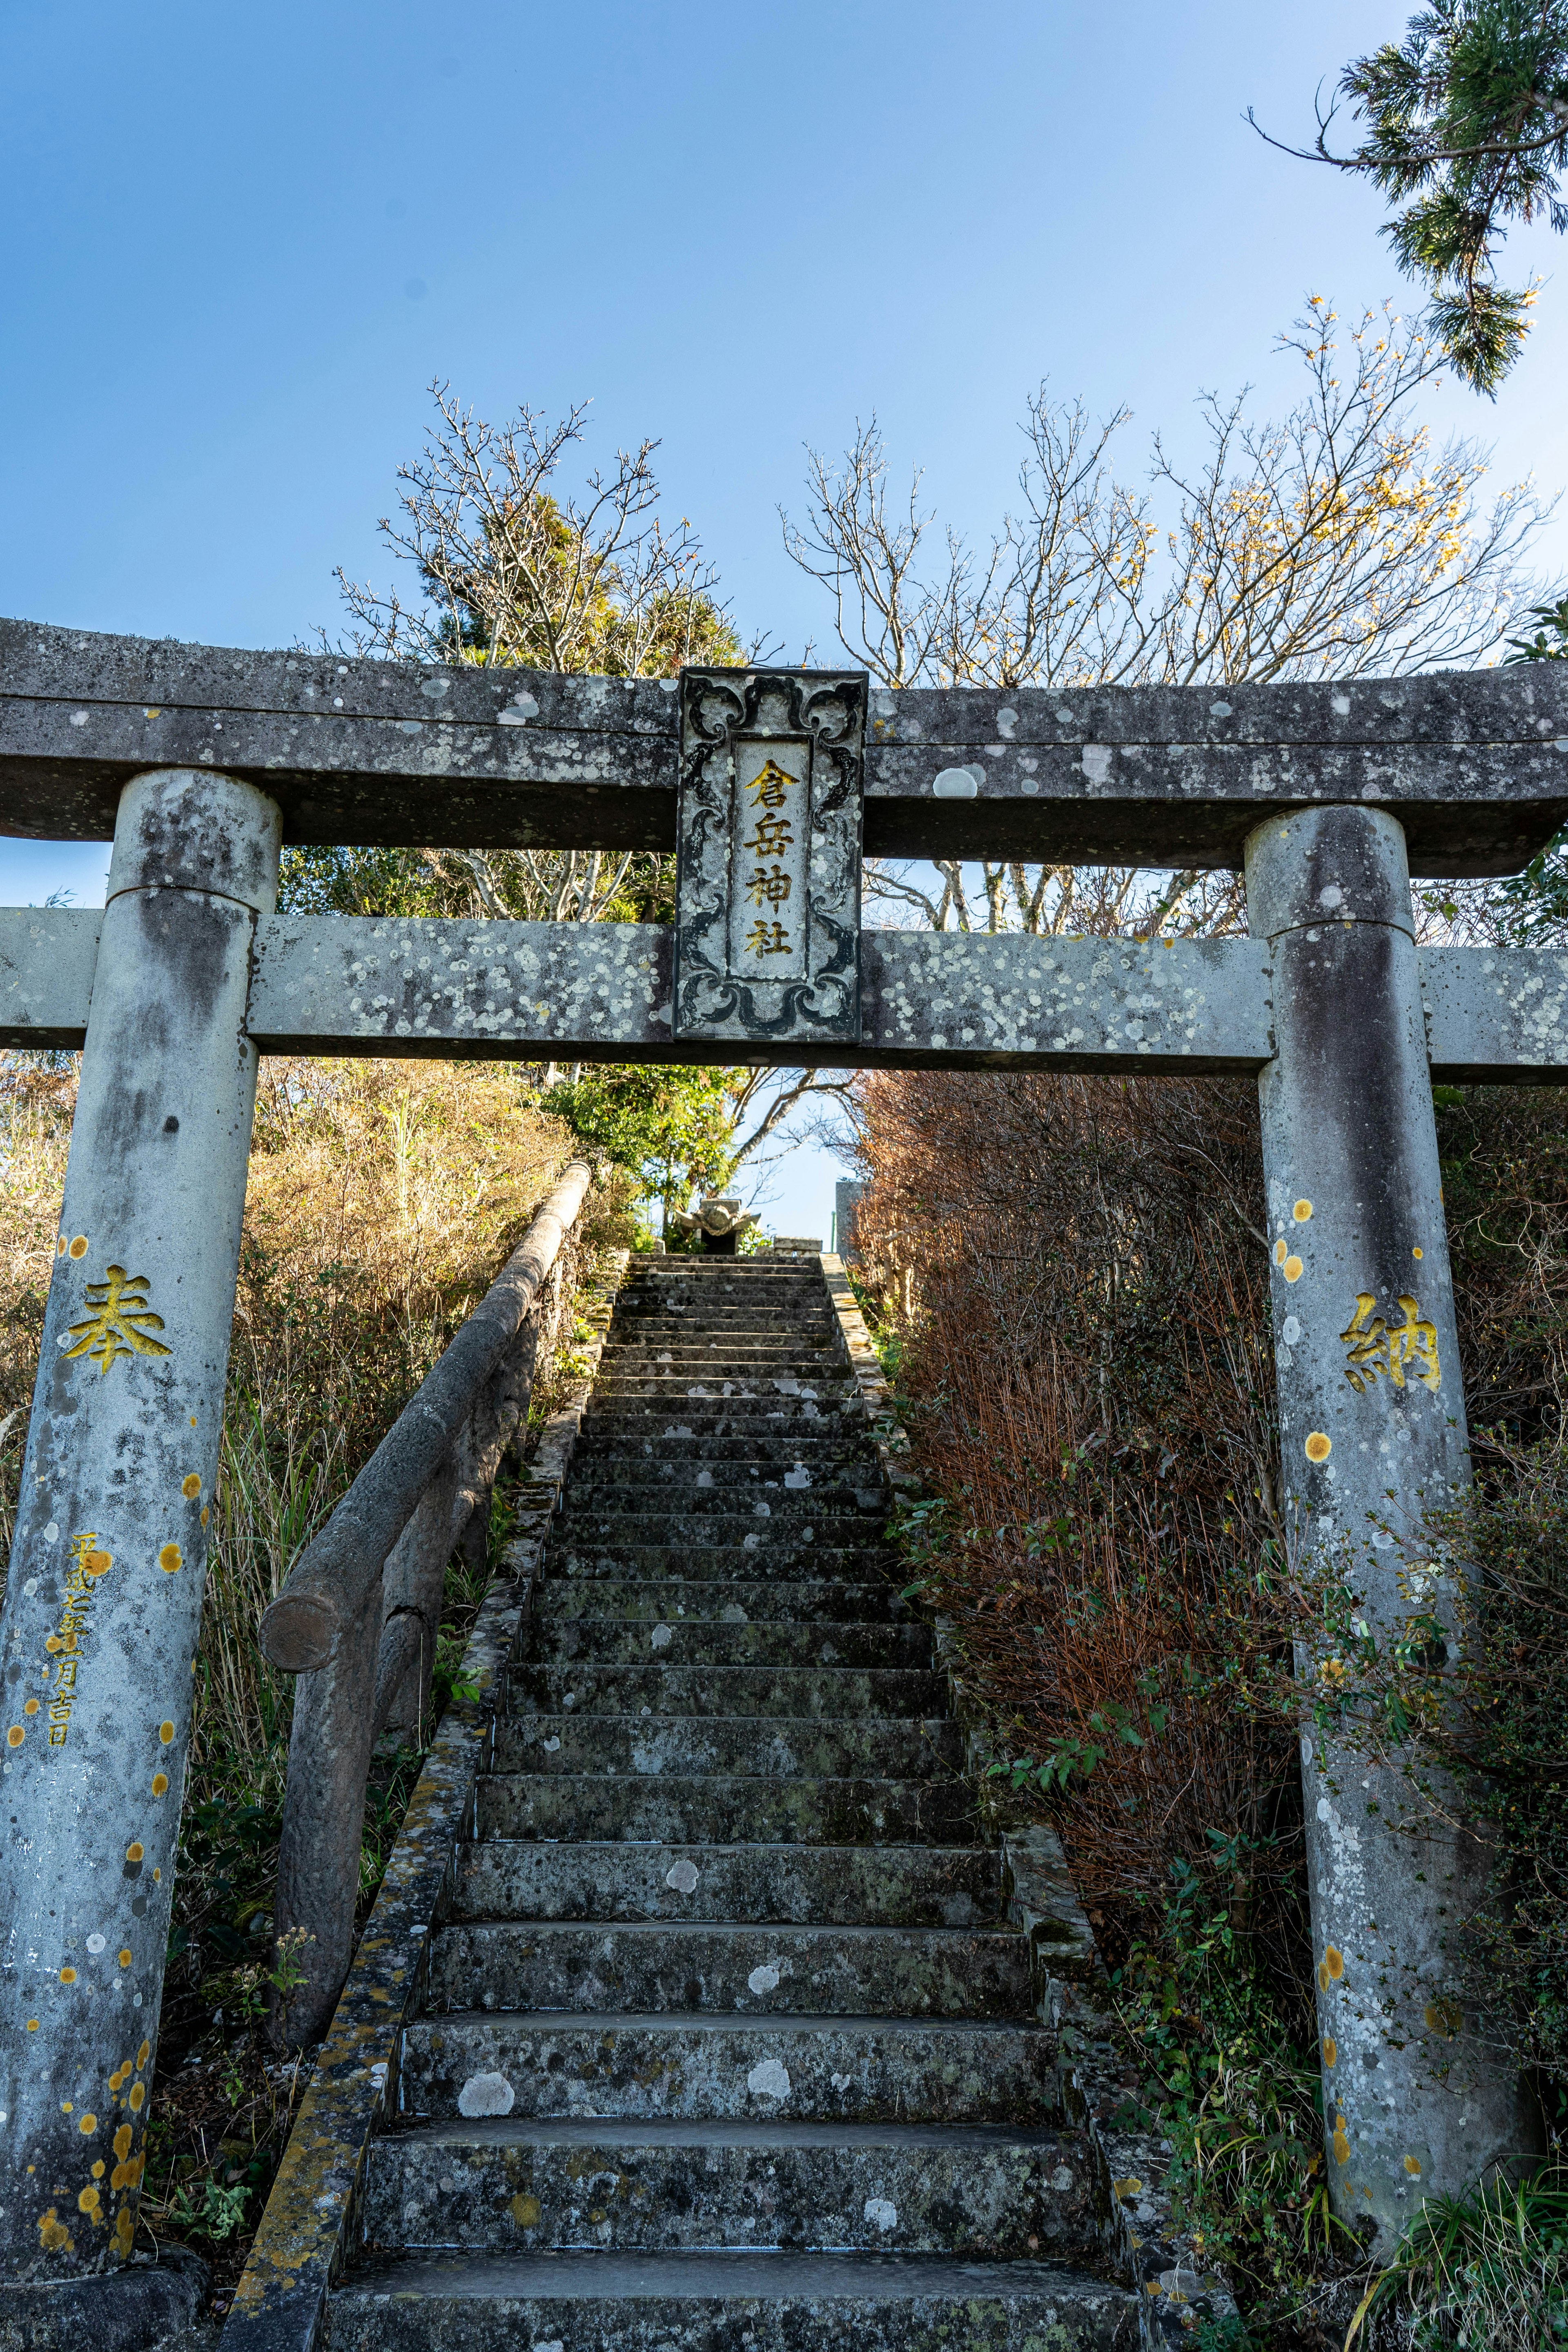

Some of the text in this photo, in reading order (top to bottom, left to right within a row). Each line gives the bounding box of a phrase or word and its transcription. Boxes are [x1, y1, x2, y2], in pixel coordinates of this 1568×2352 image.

[743, 759, 801, 959] 倉岳神社
[60, 1264, 172, 1376] 奉
[1339, 1292, 1442, 1394] 納
